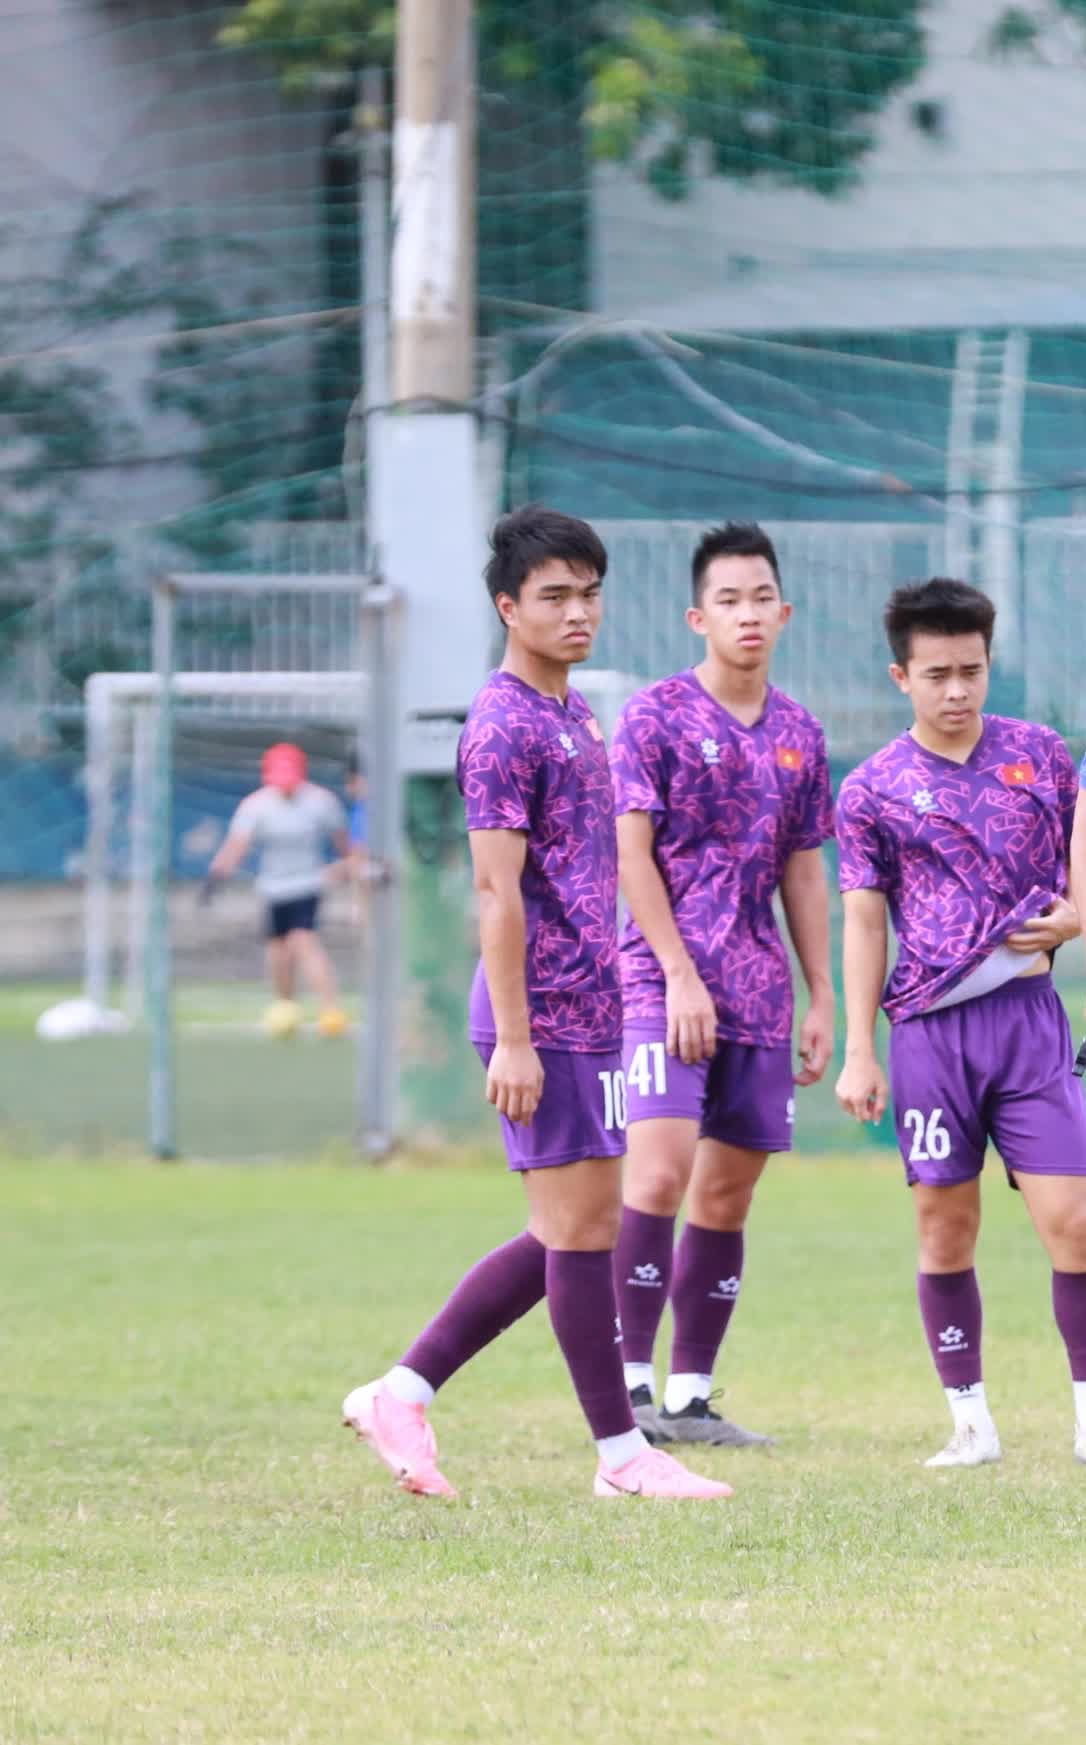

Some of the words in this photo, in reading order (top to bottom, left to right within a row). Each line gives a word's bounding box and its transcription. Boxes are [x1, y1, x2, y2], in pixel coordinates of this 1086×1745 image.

[627, 1042, 667, 1096] 41
[598, 1070, 627, 1130] 10
[904, 1108, 951, 1161] 26
